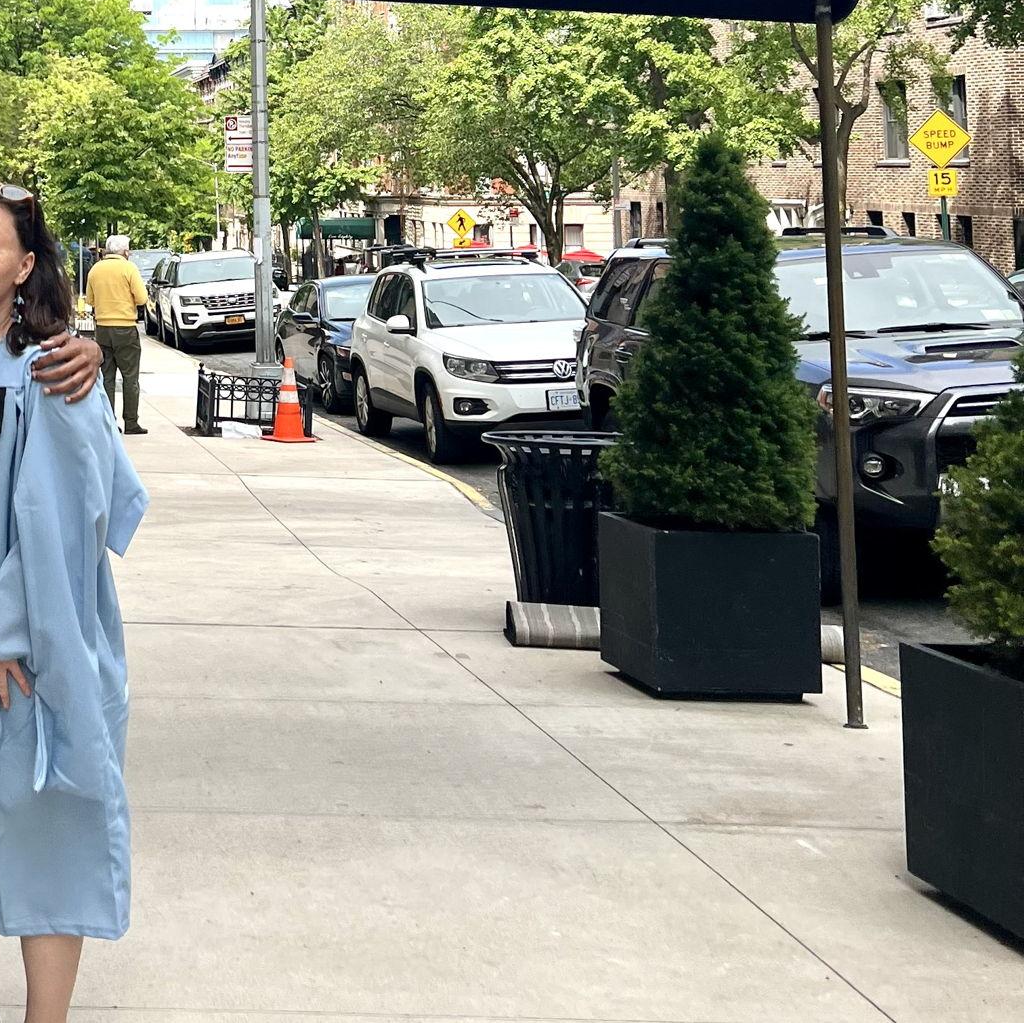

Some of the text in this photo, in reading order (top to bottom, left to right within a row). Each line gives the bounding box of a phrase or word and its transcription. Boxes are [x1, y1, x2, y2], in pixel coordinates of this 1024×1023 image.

[923, 129, 956, 139] SPEED
[926, 141, 954, 149] BUMP
[934, 172, 951, 185] 15
